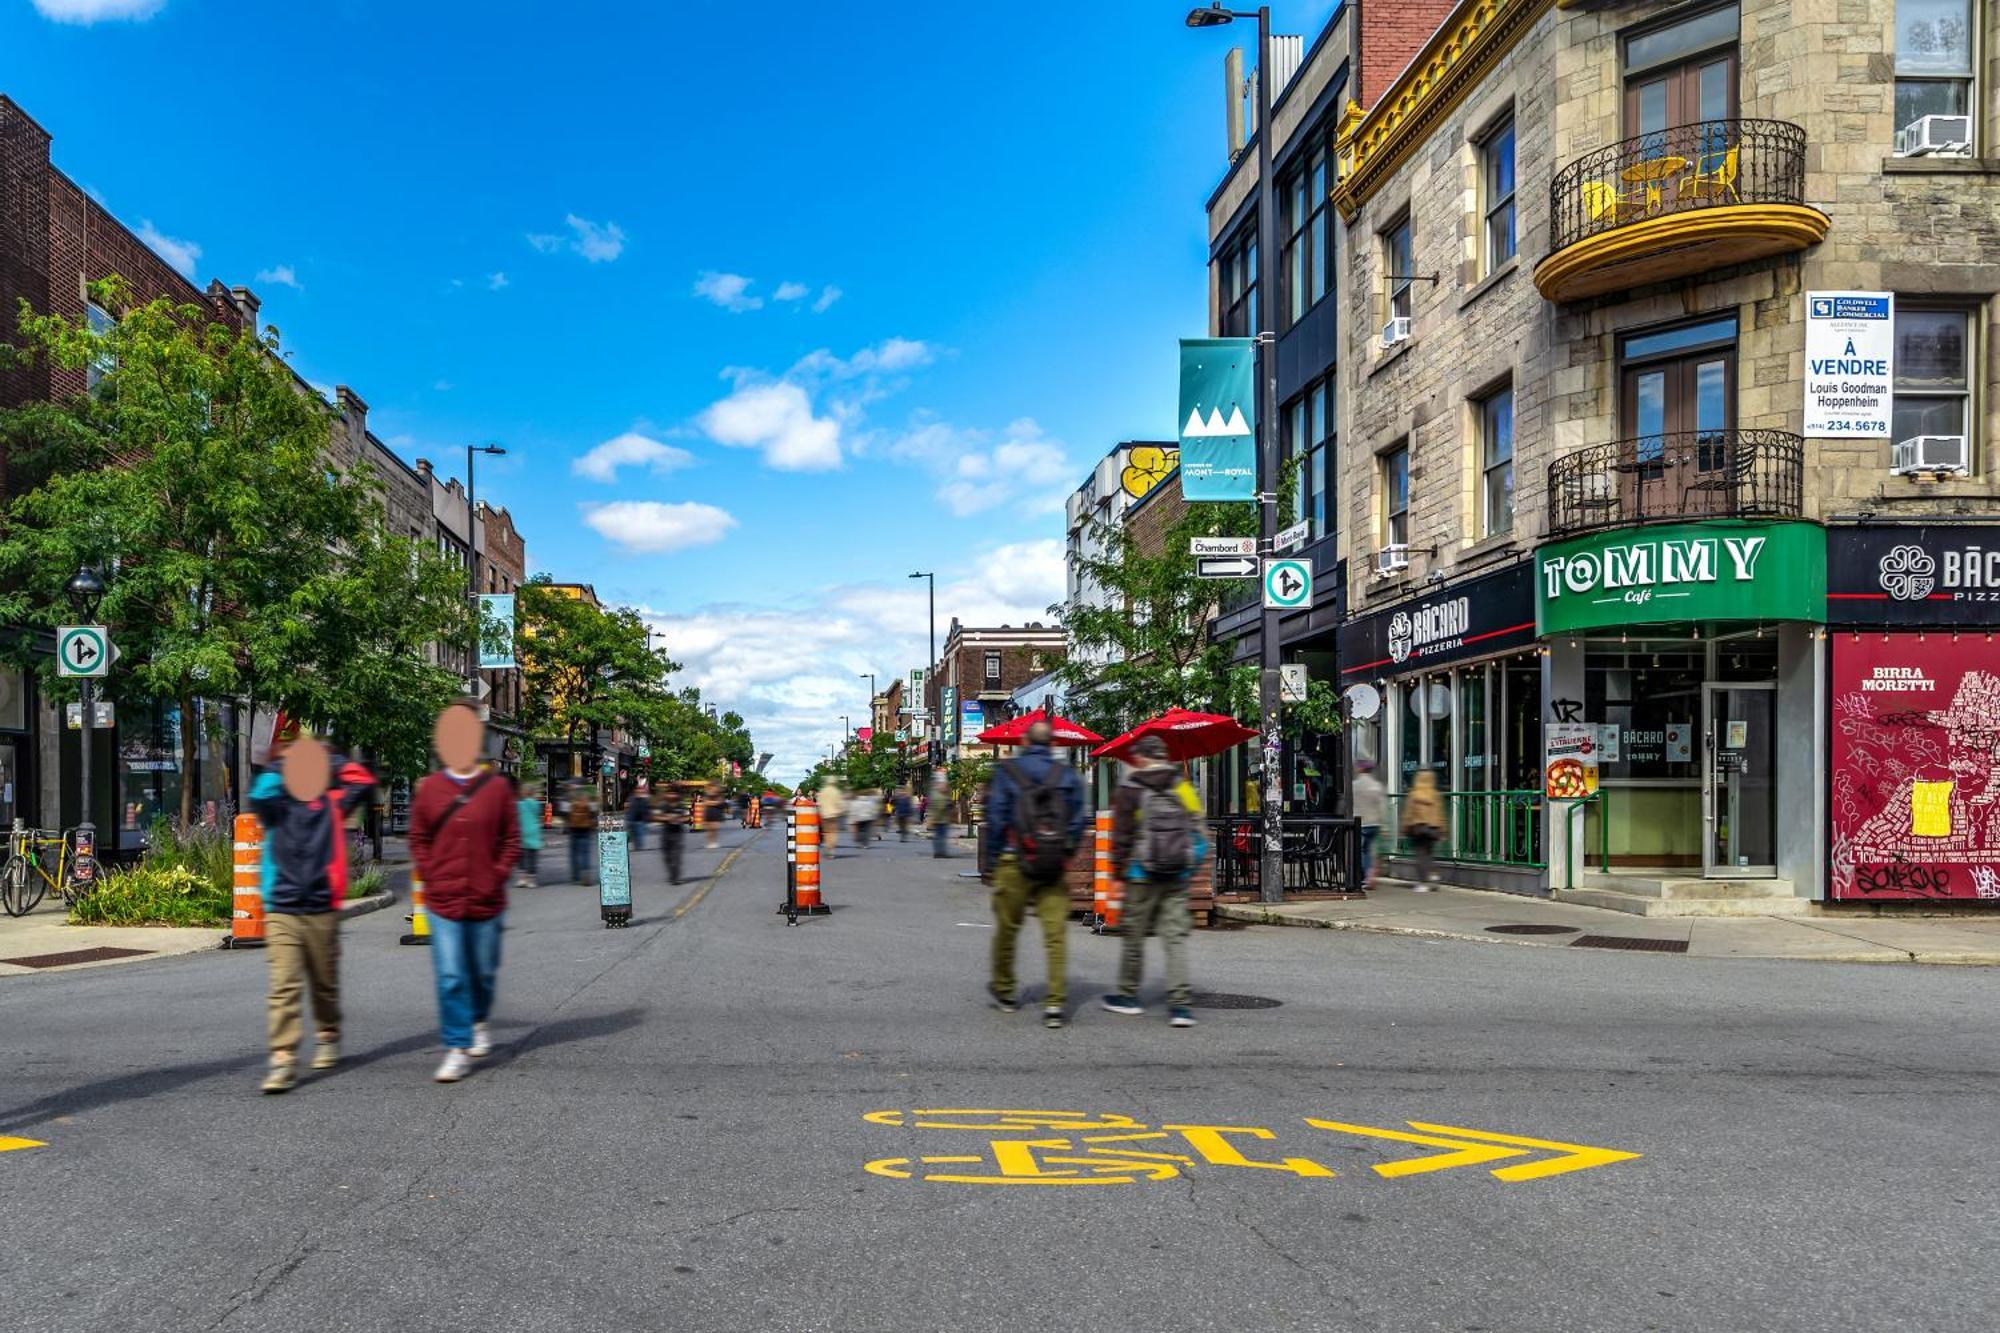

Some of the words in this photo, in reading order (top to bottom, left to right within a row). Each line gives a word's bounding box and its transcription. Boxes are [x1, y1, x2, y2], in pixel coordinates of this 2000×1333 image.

[1843, 337, 1857, 356] À
[1811, 359, 1888, 376] VENDRE
[1810, 382, 1838, 394] Louis
[1841, 382, 1888, 394] Goodman
[1817, 395, 1879, 409] Hoppenheim
[1827, 420, 1886, 431] 234.5678
[1195, 543, 1238, 553] Chambord
[1543, 537, 1766, 599] TOMMY
[1624, 588, 1652, 605] Café
[1419, 637, 1464, 657] PIZZERIA
[1872, 667, 1924, 679] BIRRA
[1861, 680, 1936, 691] MORETTI
[943, 688, 954, 741] SUBWAY
